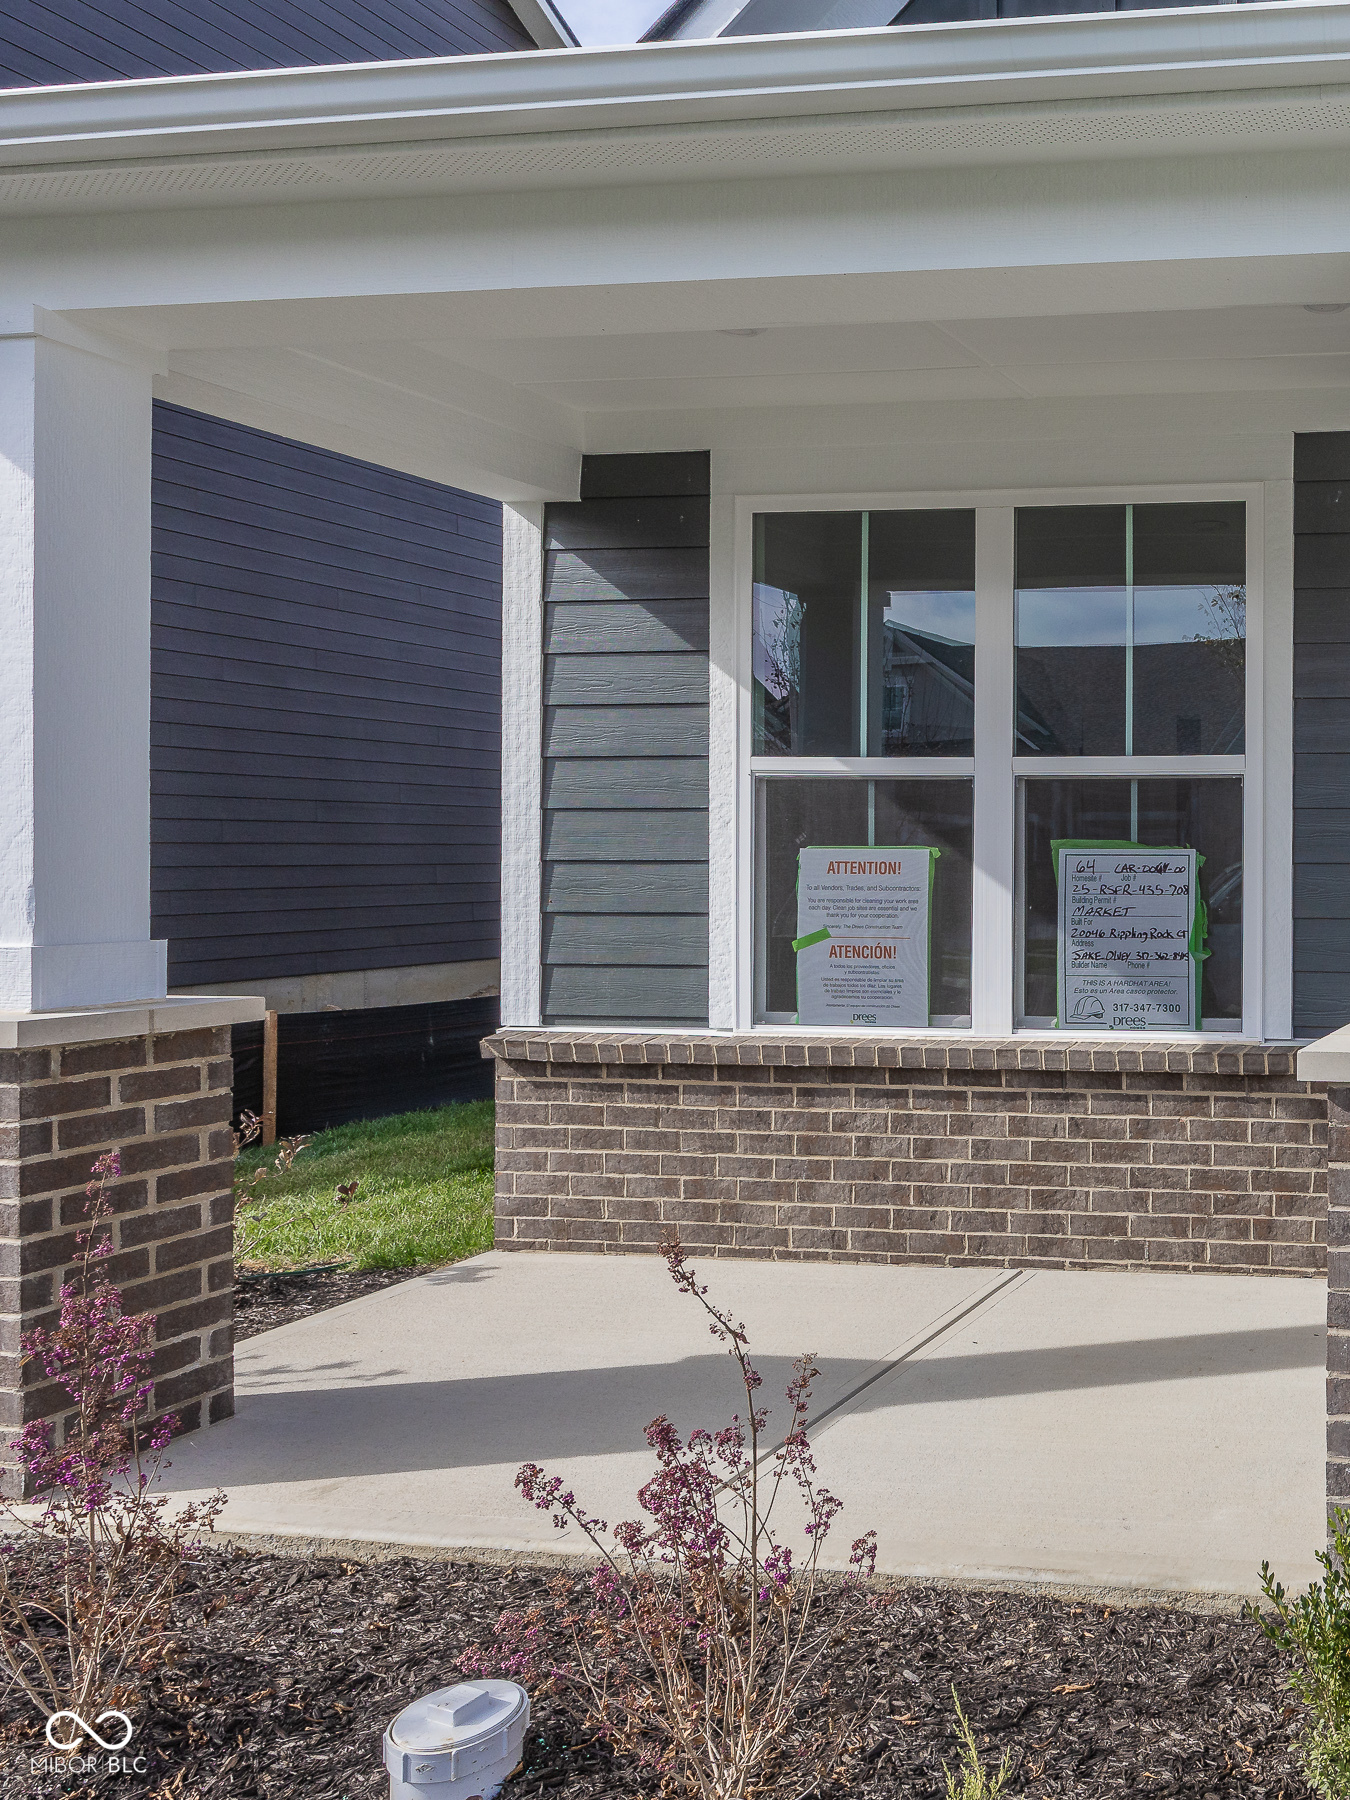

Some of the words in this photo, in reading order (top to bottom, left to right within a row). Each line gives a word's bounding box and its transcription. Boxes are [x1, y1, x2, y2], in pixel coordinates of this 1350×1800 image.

[826, 861, 902, 874] ATTENTION!
[1076, 859, 1096, 875] 64
[1072, 897, 1093, 905] Building
[1072, 906, 1136, 916] MARKET
[1150, 928, 1174, 939] Rock
[1072, 939, 1094, 947] Address
[829, 942, 897, 959] ATENCIÓN!
[1128, 961, 1145, 969] Phone
[1113, 1004, 1181, 1013] 317-347-7300
[1113, 1016, 1146, 1026] Drees
